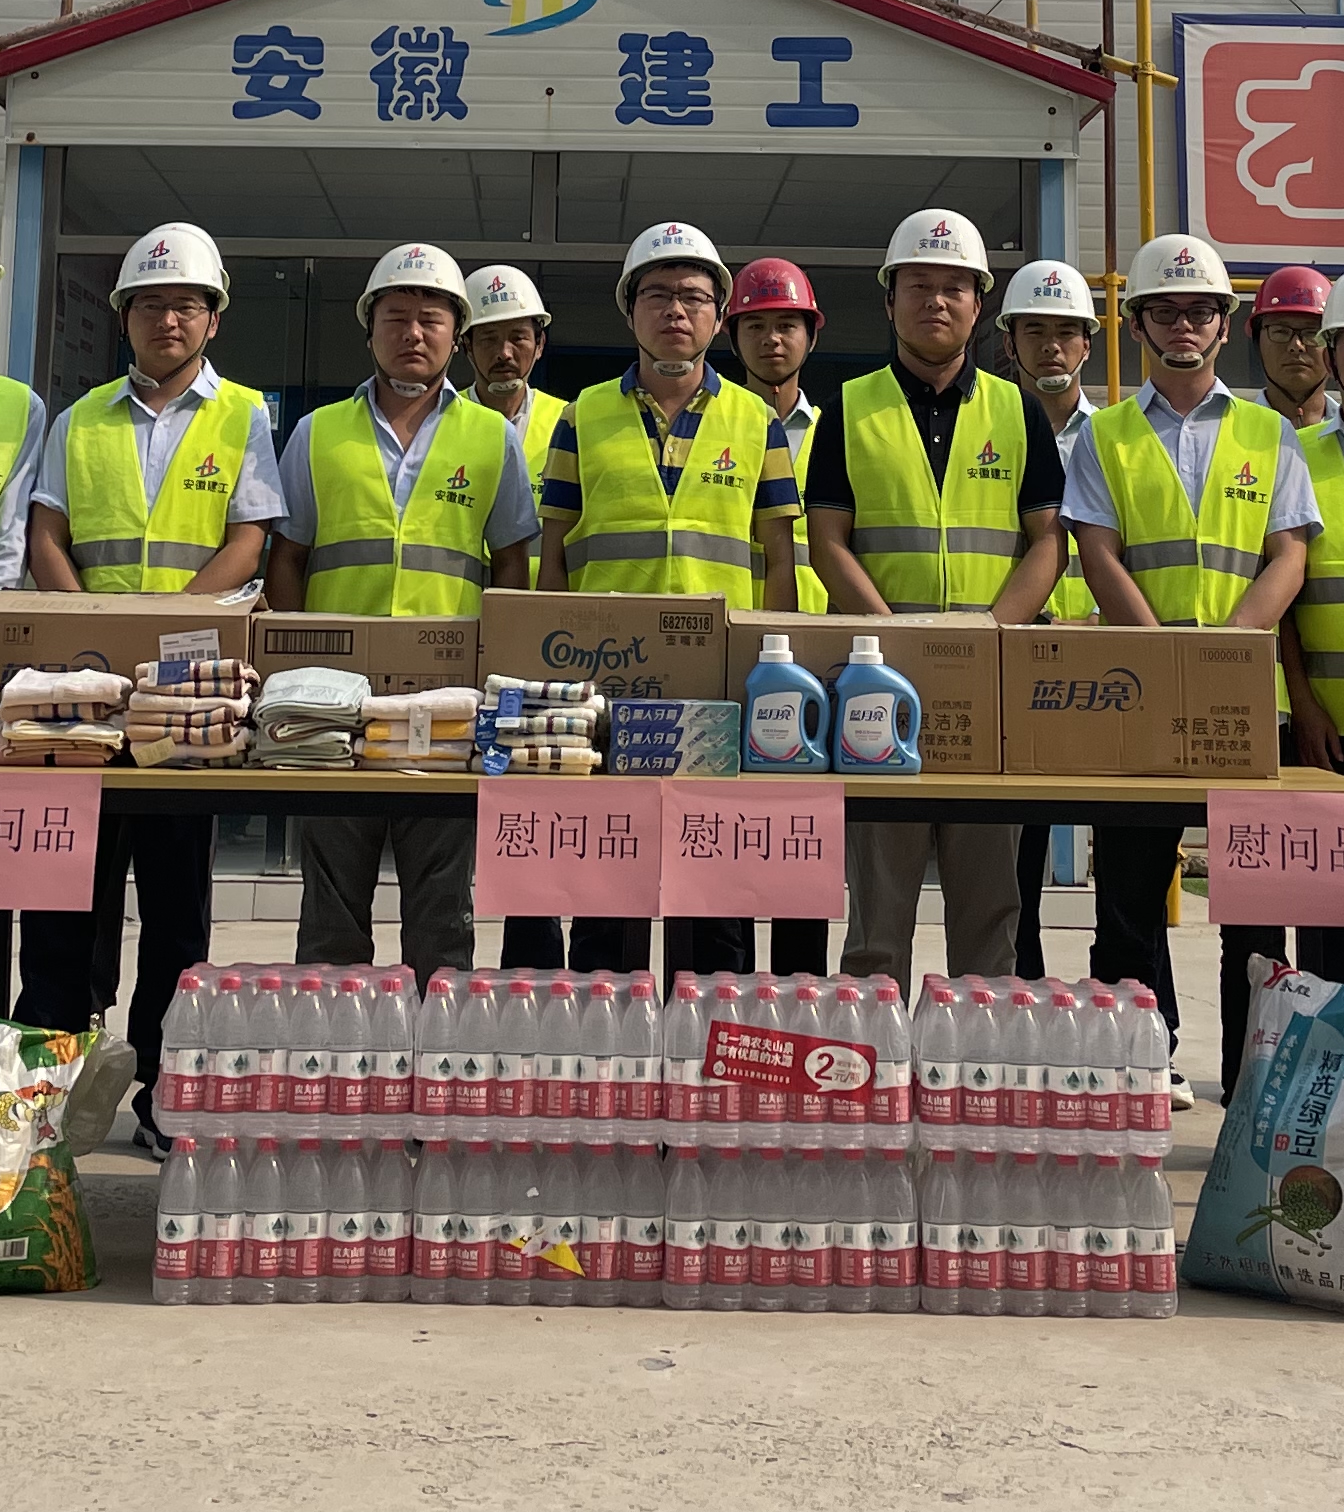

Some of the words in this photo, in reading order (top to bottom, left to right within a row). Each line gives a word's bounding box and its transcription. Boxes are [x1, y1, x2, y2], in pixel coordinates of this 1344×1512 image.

[231, 25, 859, 128] 安徽建工
[651, 236, 695, 248] 安徽建工
[923, 239, 961, 254] 安徽建工
[138, 259, 180, 273] 安徽建工
[480, 291, 519, 306] 安徽建工
[1033, 286, 1072, 301] 安徽建工
[700, 473, 745, 490] 安徽建工
[967, 467, 1012, 482] 安徽建工
[183, 480, 229, 495] 安徽建工
[1224, 486, 1269, 505] 安徽建工
[434, 490, 476, 509] 安徽建工
[663, 615, 710, 631] 68276318
[418, 630, 464, 645] 20380
[542, 630, 648, 681] Comfort
[1028, 673, 1139, 712] 蓝月亮
[1171, 717, 1251, 737] 深层洁净
[495, 810, 638, 861] 慰问品
[679, 812, 823, 862] 慰问品
[815, 1053, 835, 1080] 2
